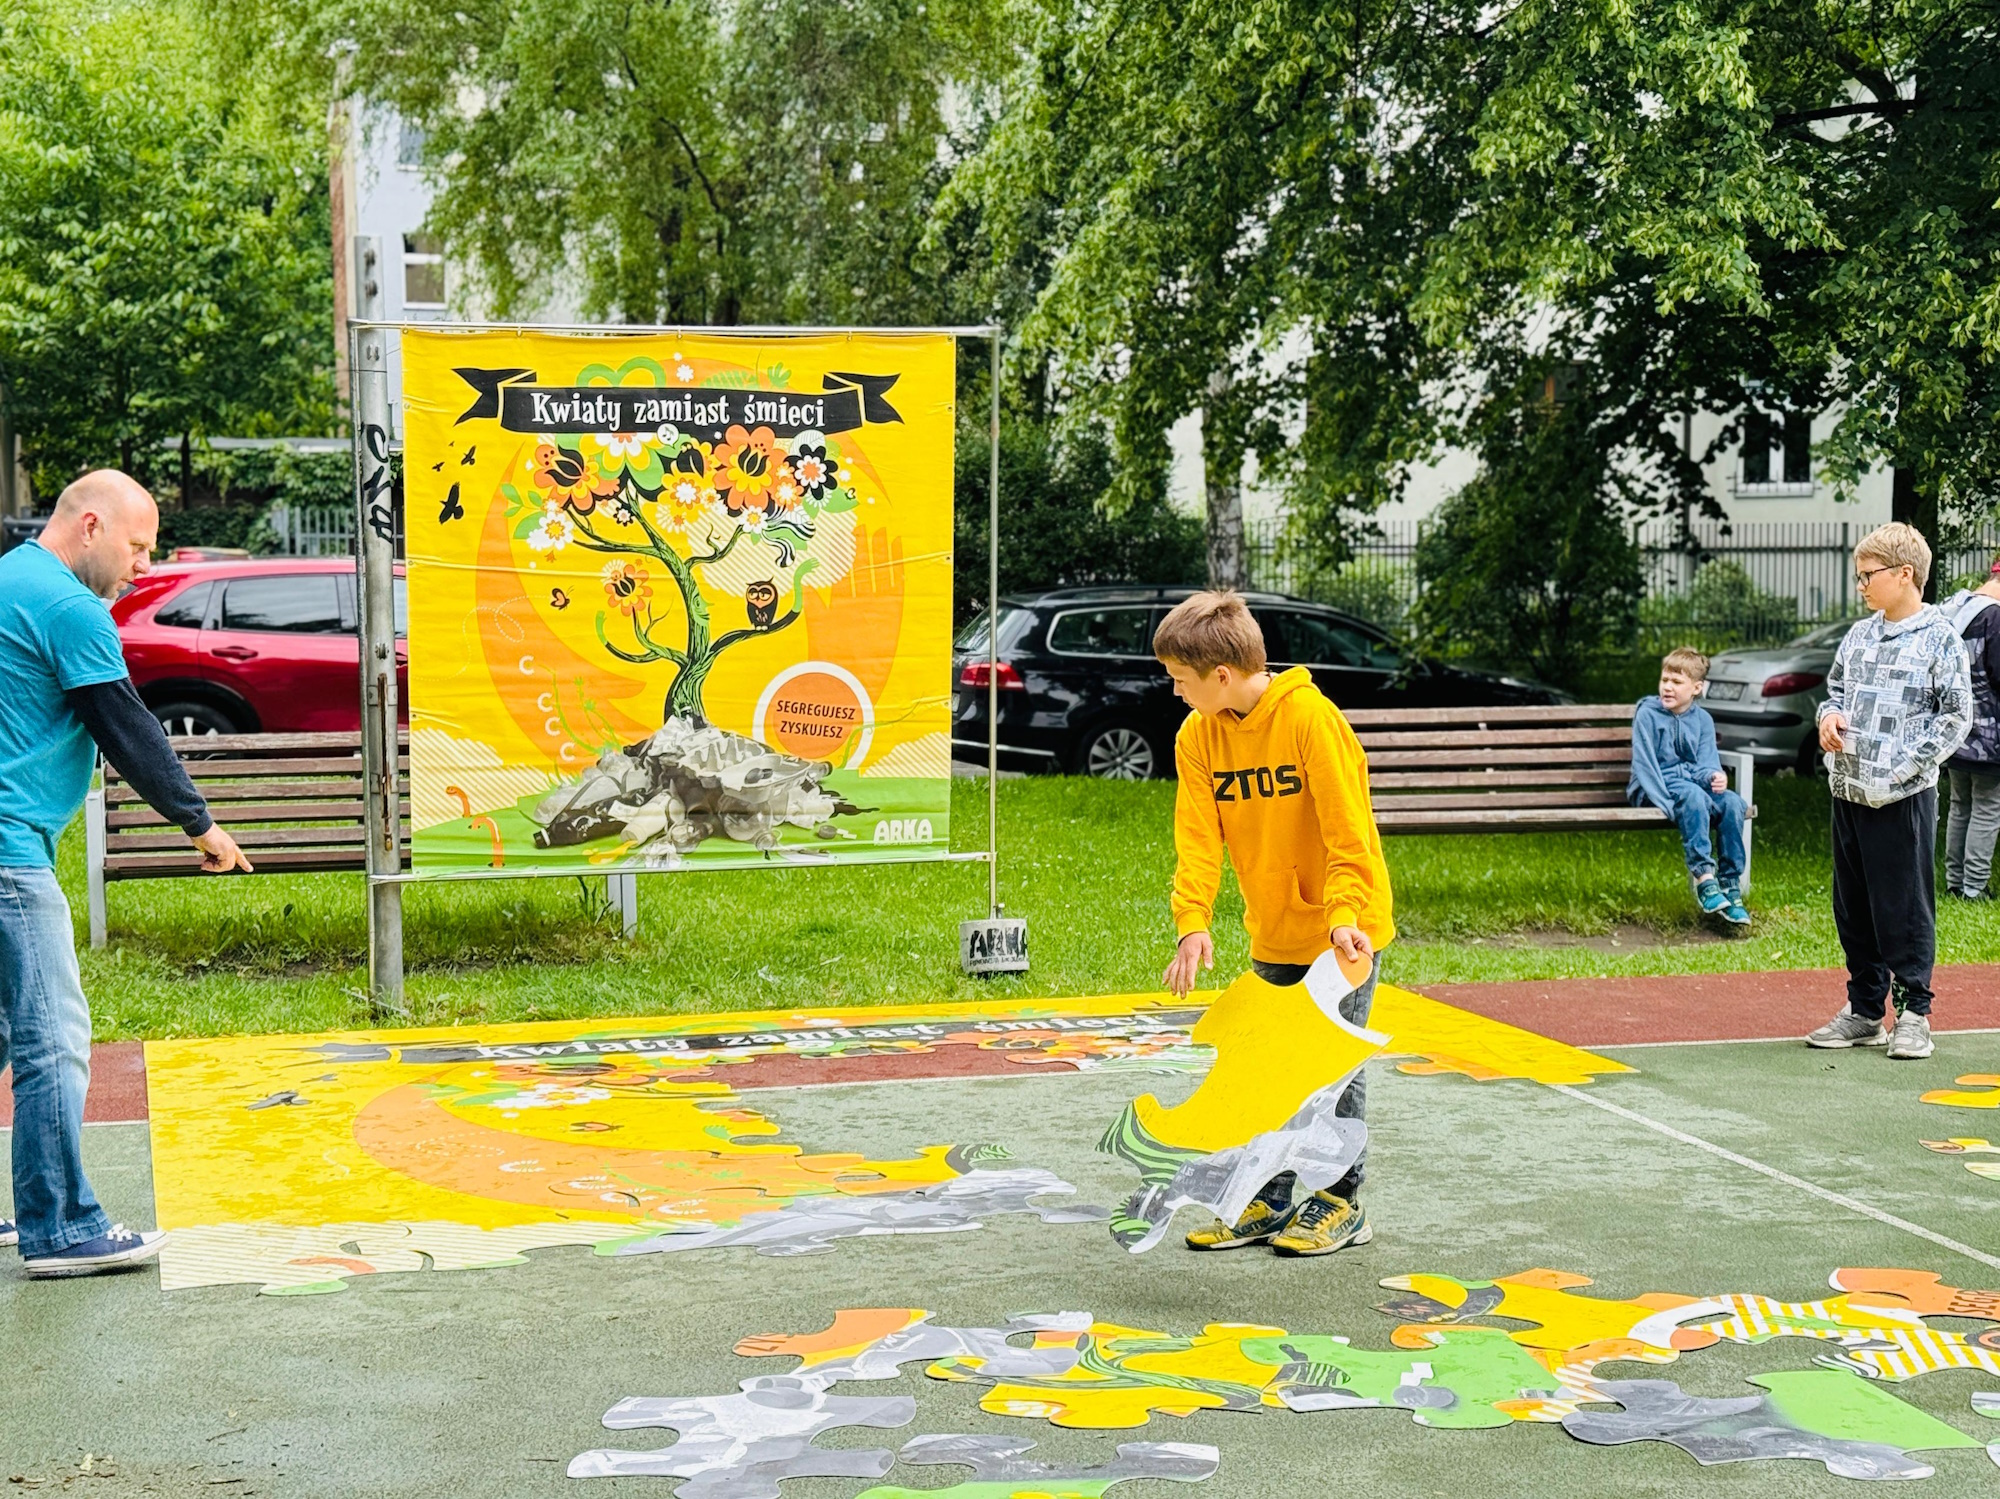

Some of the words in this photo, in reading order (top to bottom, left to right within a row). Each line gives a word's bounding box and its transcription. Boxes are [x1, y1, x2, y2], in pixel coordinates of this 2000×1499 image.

[530, 392, 621, 431] Kwiaty
[634, 392, 730, 426] zamiast
[744, 394, 826, 427] śmieci
[776, 700, 856, 720] SEGREGUJESZ
[780, 720, 843, 739] ZYSKUJESZ
[1213, 764, 1303, 802] ZTOS
[873, 818, 933, 844] ARKA
[475, 1036, 691, 1060] Kwiaty
[719, 1023, 945, 1047] zamiast
